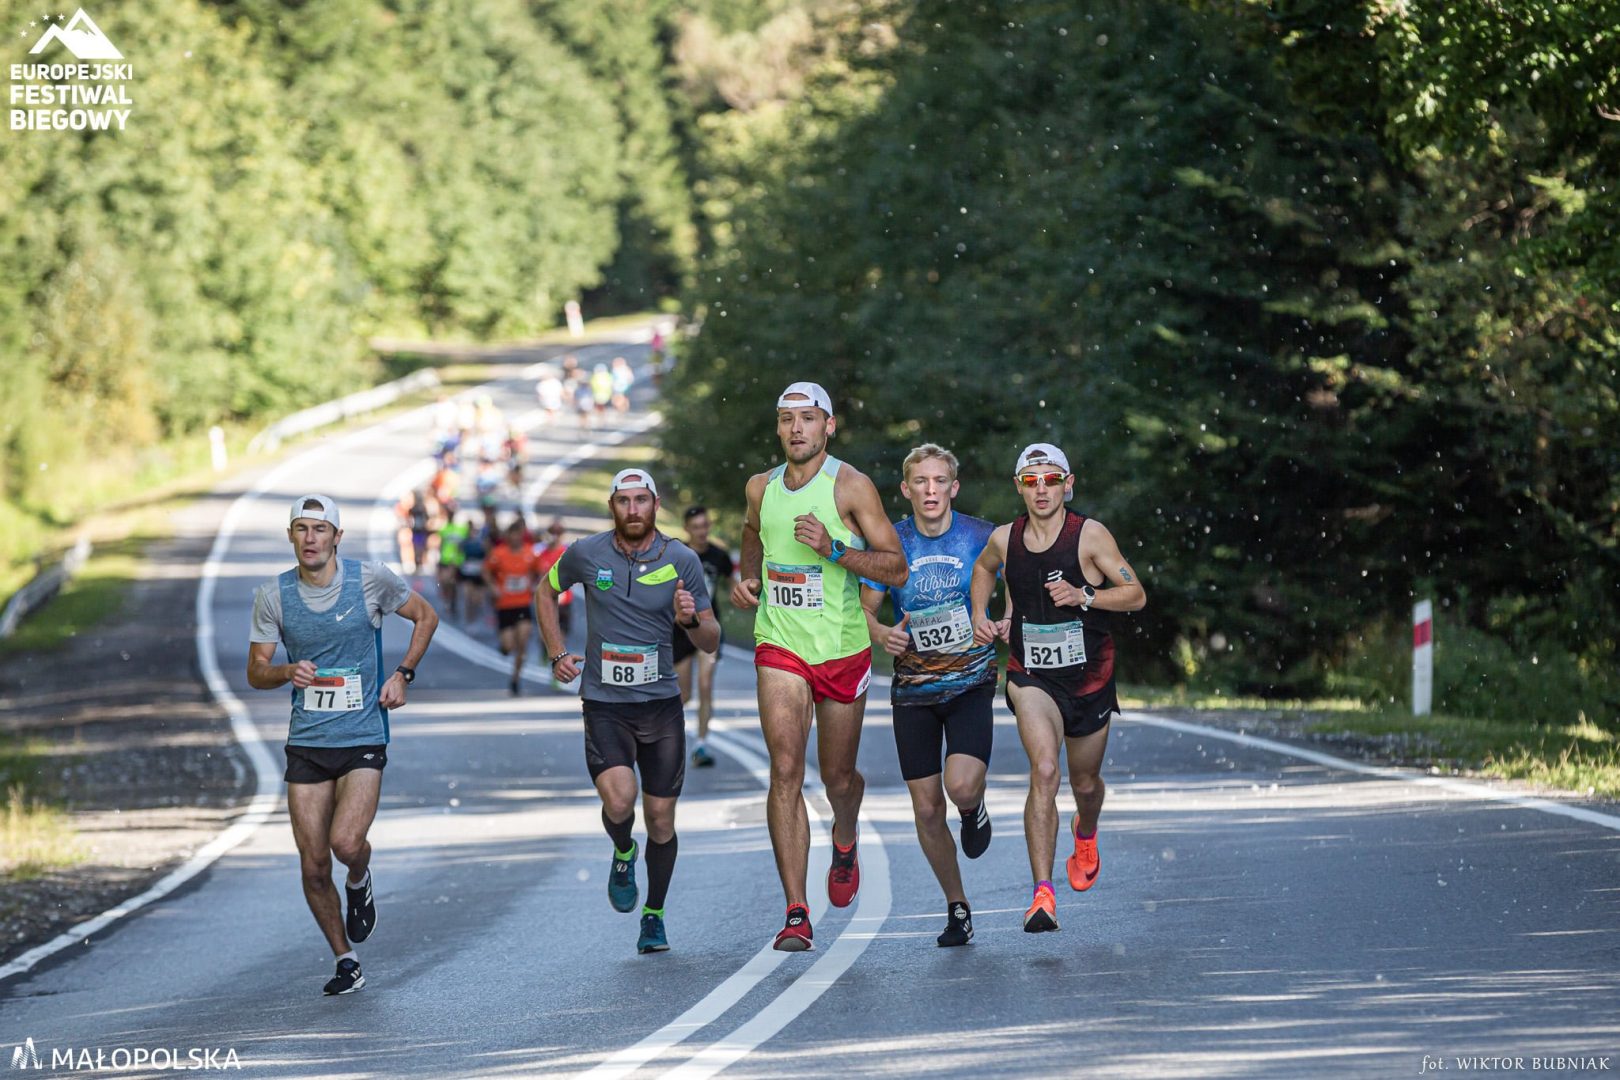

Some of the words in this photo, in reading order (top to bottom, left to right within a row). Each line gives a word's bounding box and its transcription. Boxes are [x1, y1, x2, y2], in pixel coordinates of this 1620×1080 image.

[914, 574, 960, 592] World
[773, 585, 803, 607] 105
[918, 625, 955, 648] 532
[1030, 646, 1063, 666] 521
[613, 665, 634, 683] 68
[314, 690, 336, 709] 77
